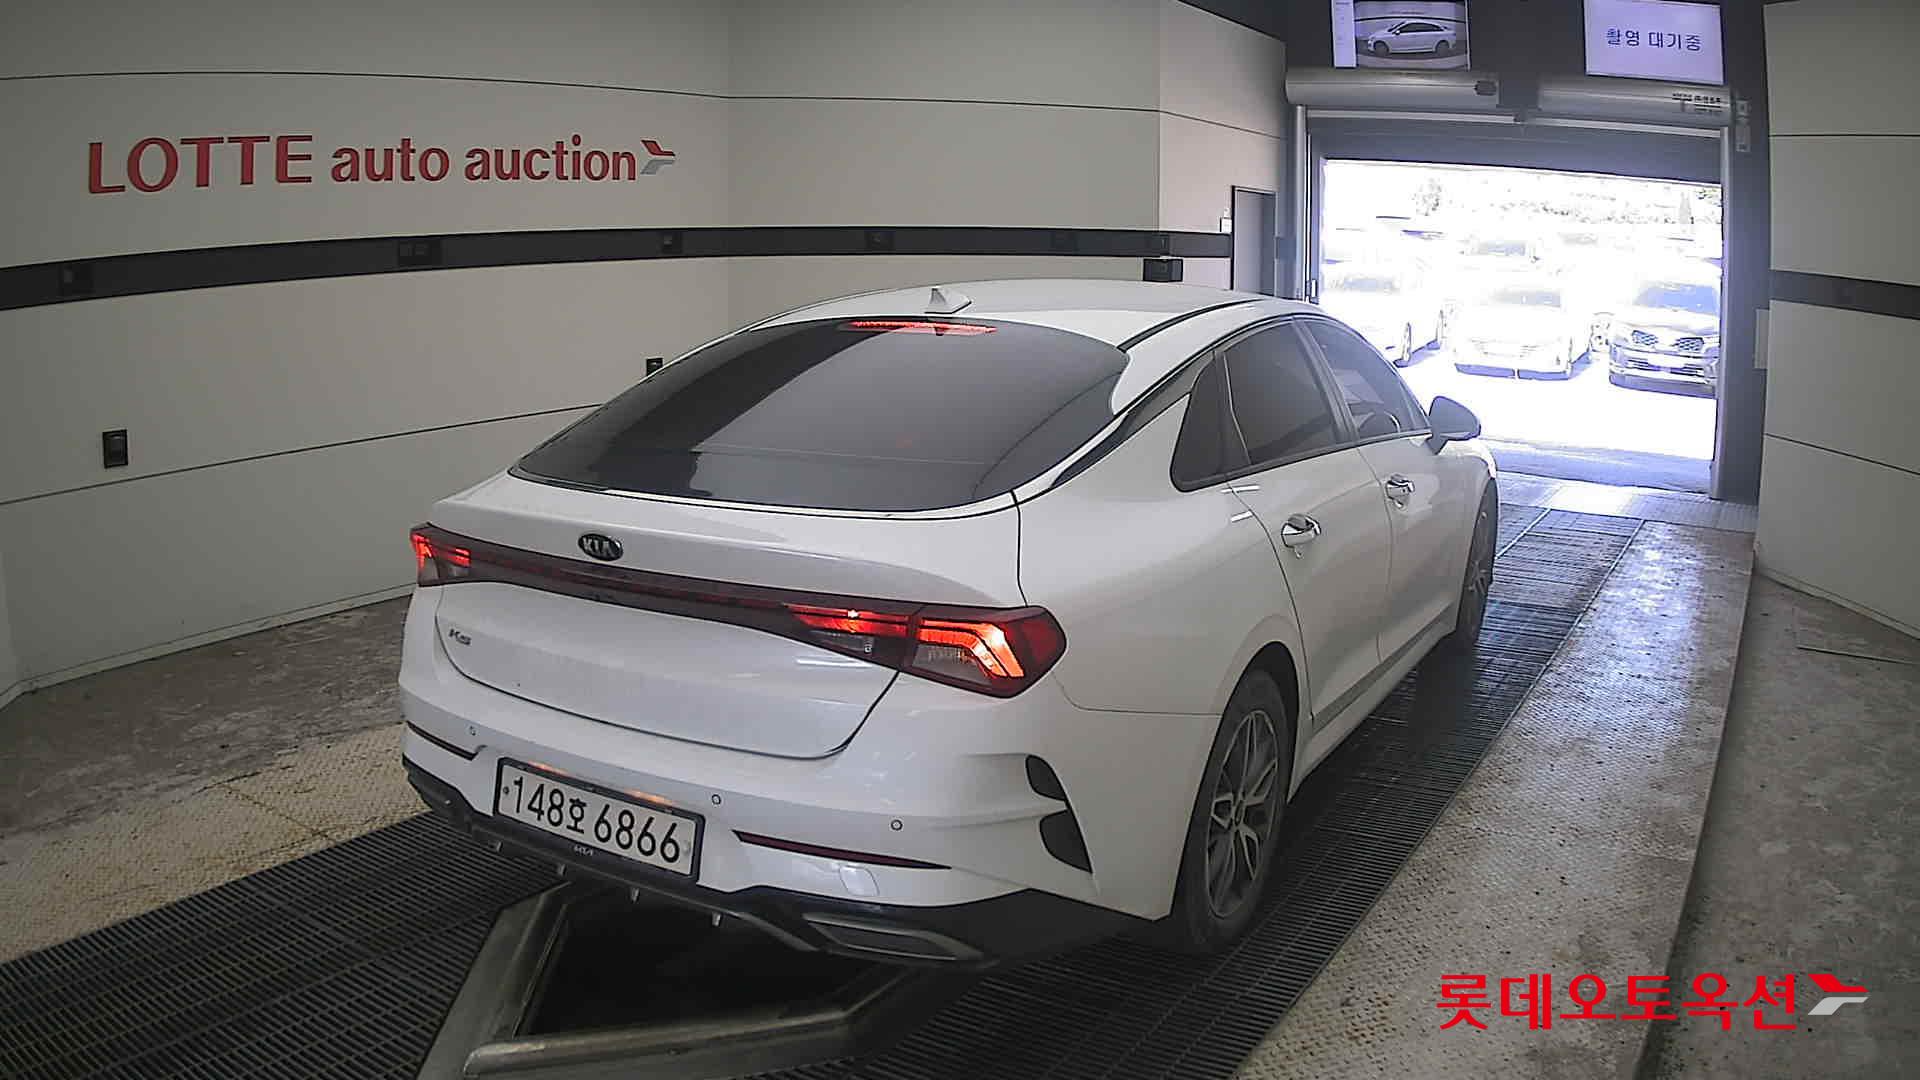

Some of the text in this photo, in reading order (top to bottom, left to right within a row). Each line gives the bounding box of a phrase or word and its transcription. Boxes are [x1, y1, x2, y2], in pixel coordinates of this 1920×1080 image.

[1607, 28, 1701, 52] 촬영 대기중
[88, 134, 637, 195] LOTTE auto auction
[581, 536, 614, 558] KIA
[513, 775, 681, 864] 148호 6866
